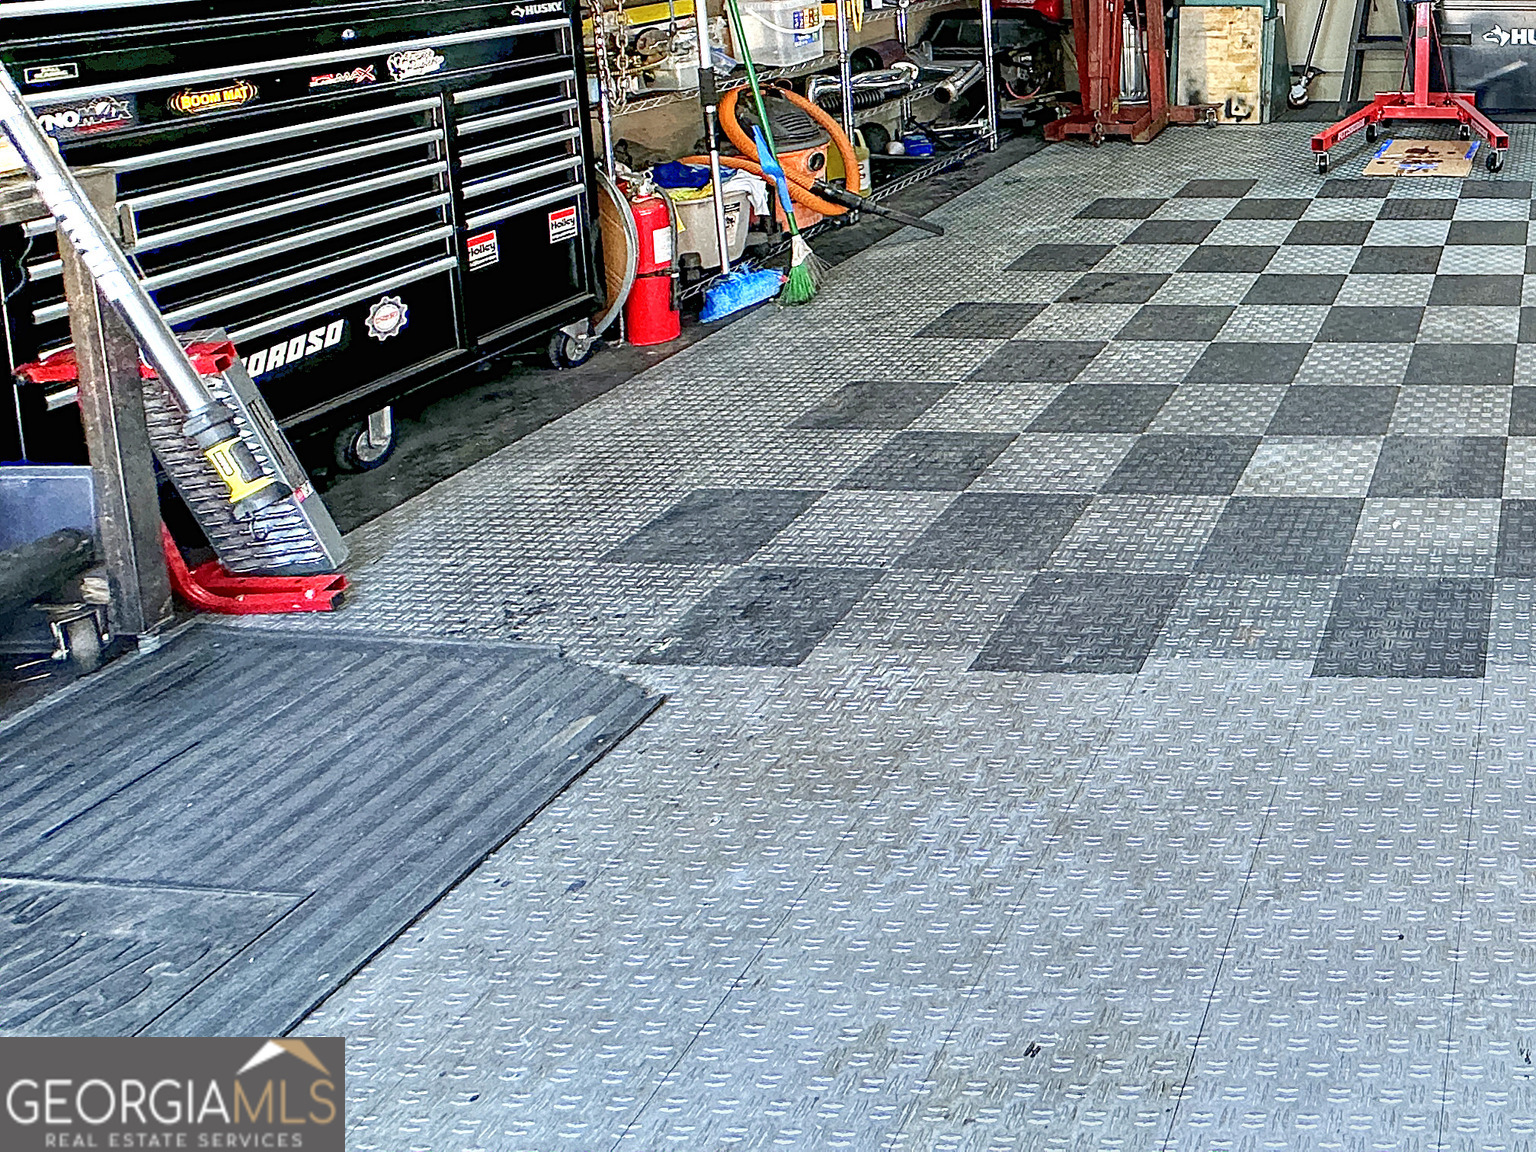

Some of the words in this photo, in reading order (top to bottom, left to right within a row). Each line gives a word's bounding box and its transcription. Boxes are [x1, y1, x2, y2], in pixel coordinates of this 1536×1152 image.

[525, 2, 562, 16] HUSKY
[179, 92, 222, 110] BOOM
[223, 86, 249, 105] MAT
[36, 98, 133, 133] YNOMAX
